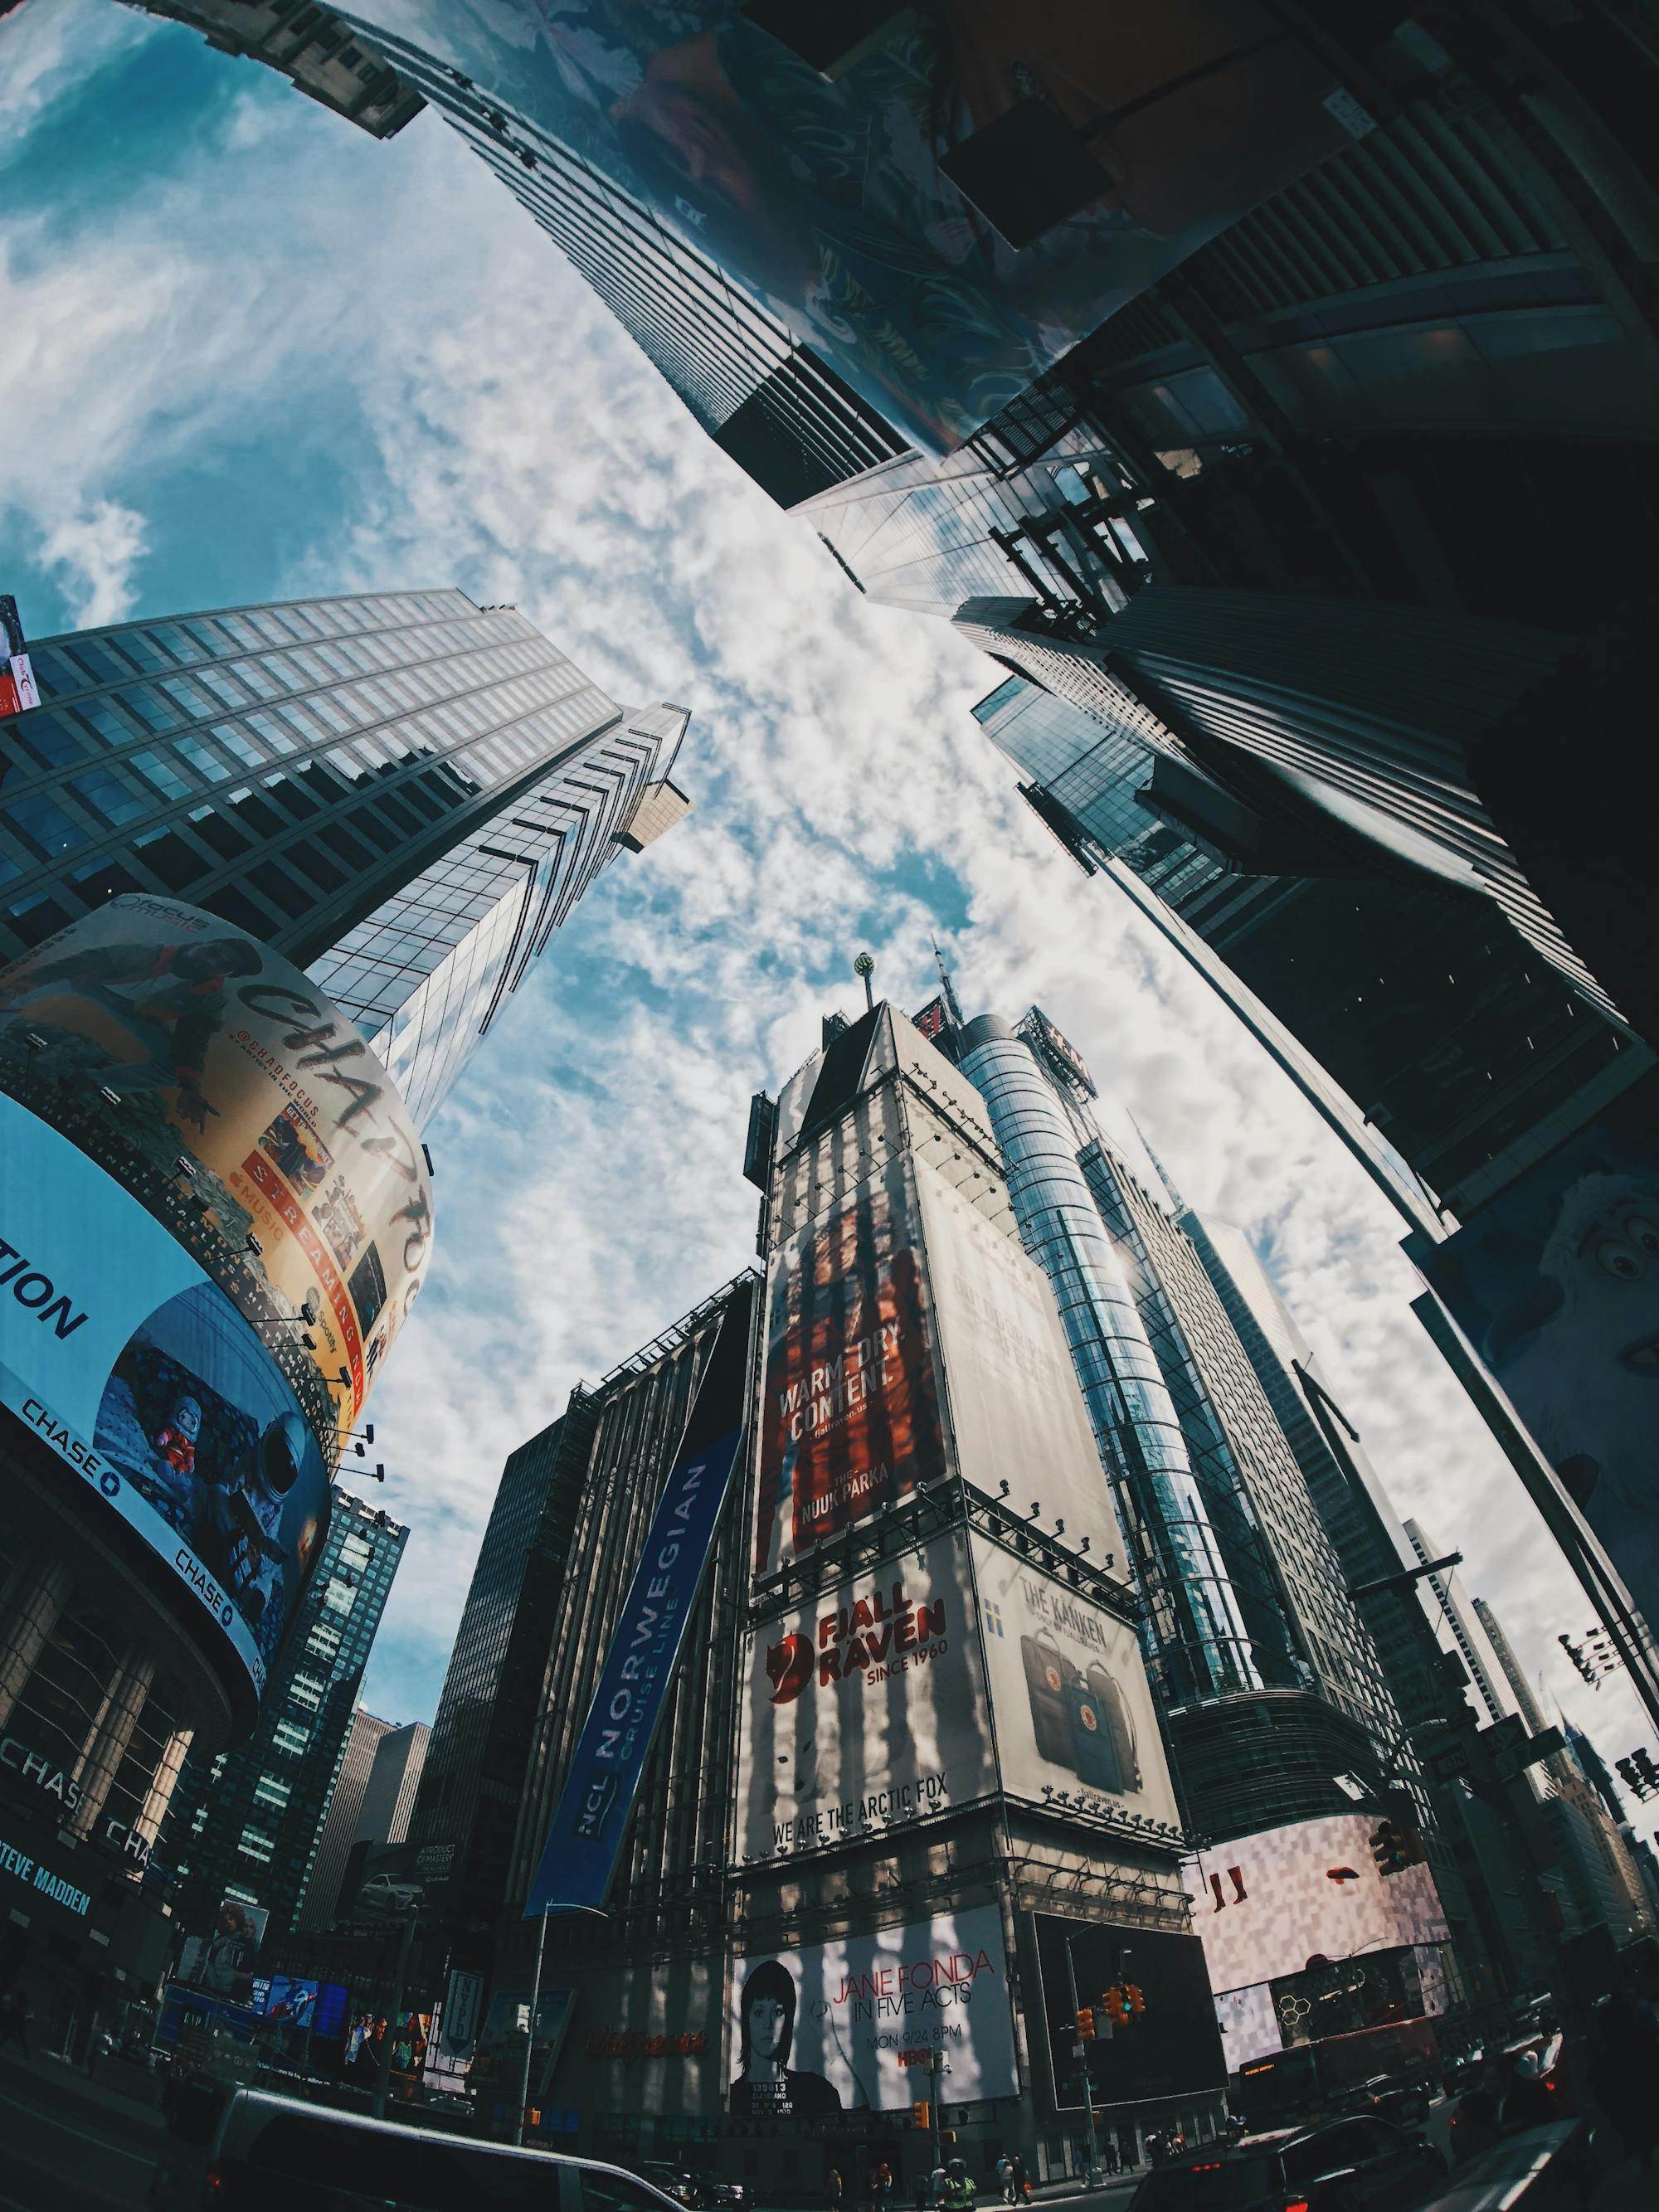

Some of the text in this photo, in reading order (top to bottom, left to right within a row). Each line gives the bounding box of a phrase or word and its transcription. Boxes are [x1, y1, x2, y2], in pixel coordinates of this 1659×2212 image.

[17, 658, 26, 676] Club
[129, 904, 200, 934] music
[142, 899, 210, 930] focus
[238, 1030, 319, 1117] @CHADFOCUS
[240, 1044, 267, 1071] ARTIST
[268, 1072, 279, 1082] IN
[278, 1082, 293, 1097] THE
[293, 1097, 318, 1128] WORLD
[241, 1187, 284, 1242] MUSIC
[255, 1164, 354, 1343] STREAMING
[351, 1354, 364, 1406] NOW
[318, 1310, 337, 1354] Spotify
[780, 1354, 850, 1418] WARM.
[857, 1317, 906, 1369] DRY.
[791, 1354, 894, 1442] CONTENT.
[22, 1398, 102, 1479] CHASE
[802, 1462, 888, 1526] NUUK PARKA
[834, 1469, 853, 1487] THE
[175, 1548, 224, 1614] CHASE
[1019, 1576, 1050, 1615] THE
[596, 1464, 707, 1759] NORWEGIAN
[820, 1581, 913, 1649] FJÄLL
[819, 1597, 946, 1687] RÄVEN
[867, 1639, 948, 1686] SINCE 1960
[618, 1597, 679, 1763] CRUISE LINE
[577, 1773, 609, 1838] NCL
[772, 1772, 949, 1846] WE ARE THE ARCTIC FOX
[426, 1844, 455, 1855] PRODUCT
[426, 1853, 455, 1864] MASTERY
[33, 1866, 90, 1917] MADDEN
[834, 1949, 995, 2005] JANE FONDA
[854, 1981, 972, 2022] IN FIVE ACTS
[457, 1977, 472, 2037] NYPD
[866, 2023, 962, 2051] MON 9/24 8PM
[897, 2048, 931, 2068] HBO
